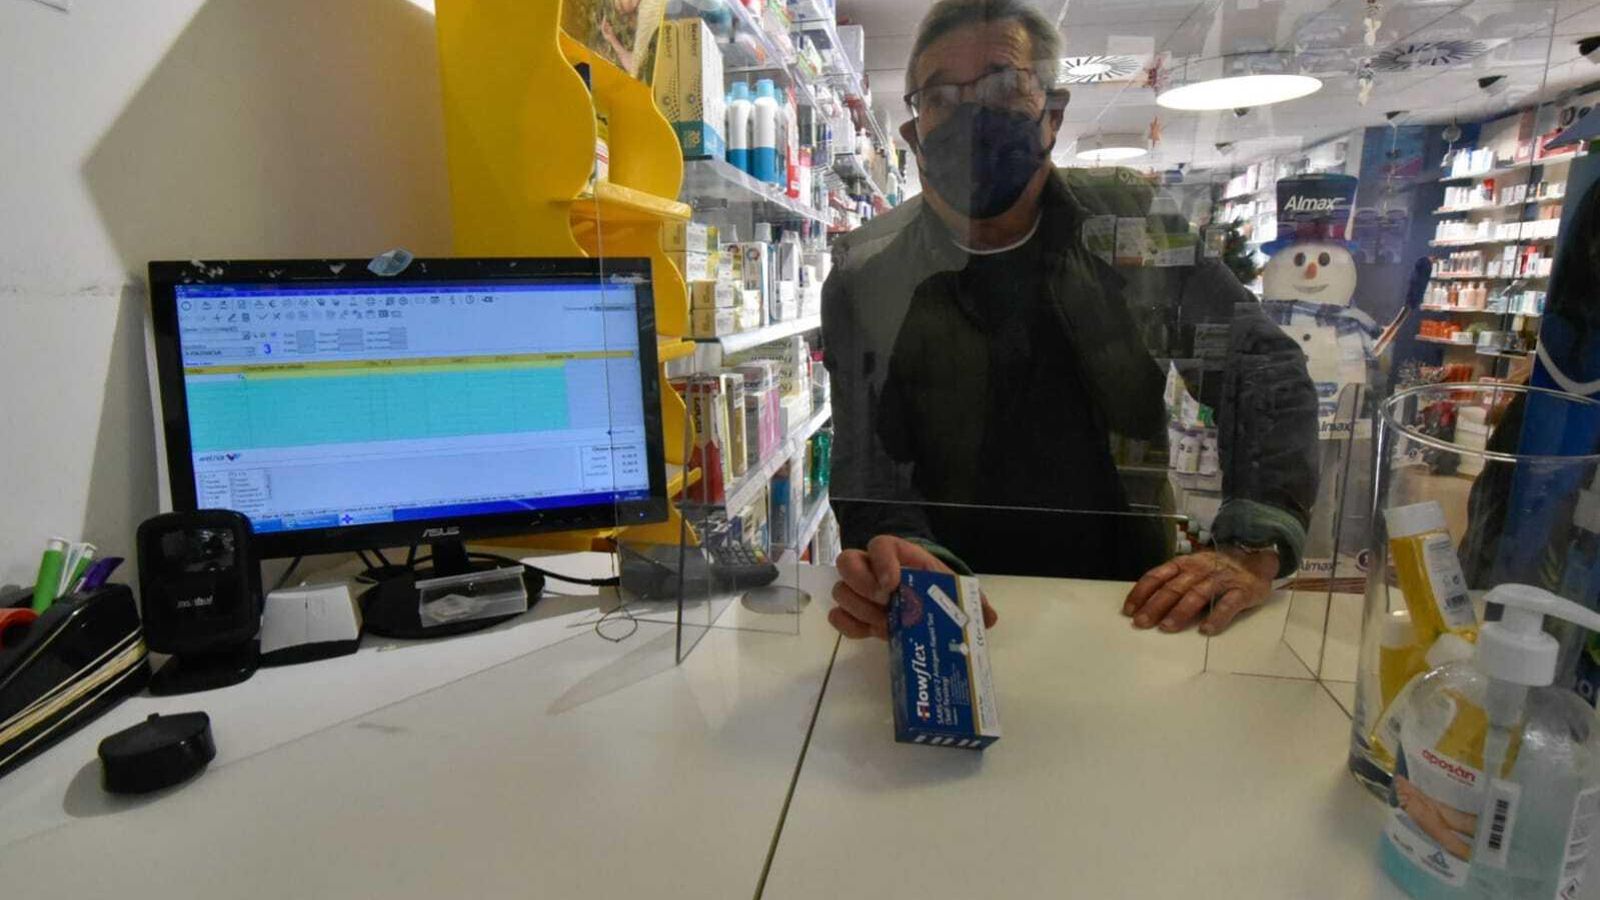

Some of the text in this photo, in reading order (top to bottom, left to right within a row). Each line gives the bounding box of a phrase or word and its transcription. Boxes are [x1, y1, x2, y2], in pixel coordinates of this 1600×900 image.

[1284, 194, 1346, 211] Almax
[263, 343, 271, 354] 3
[422, 526, 460, 538] ASUS
[911, 642, 932, 720] Flowflex
